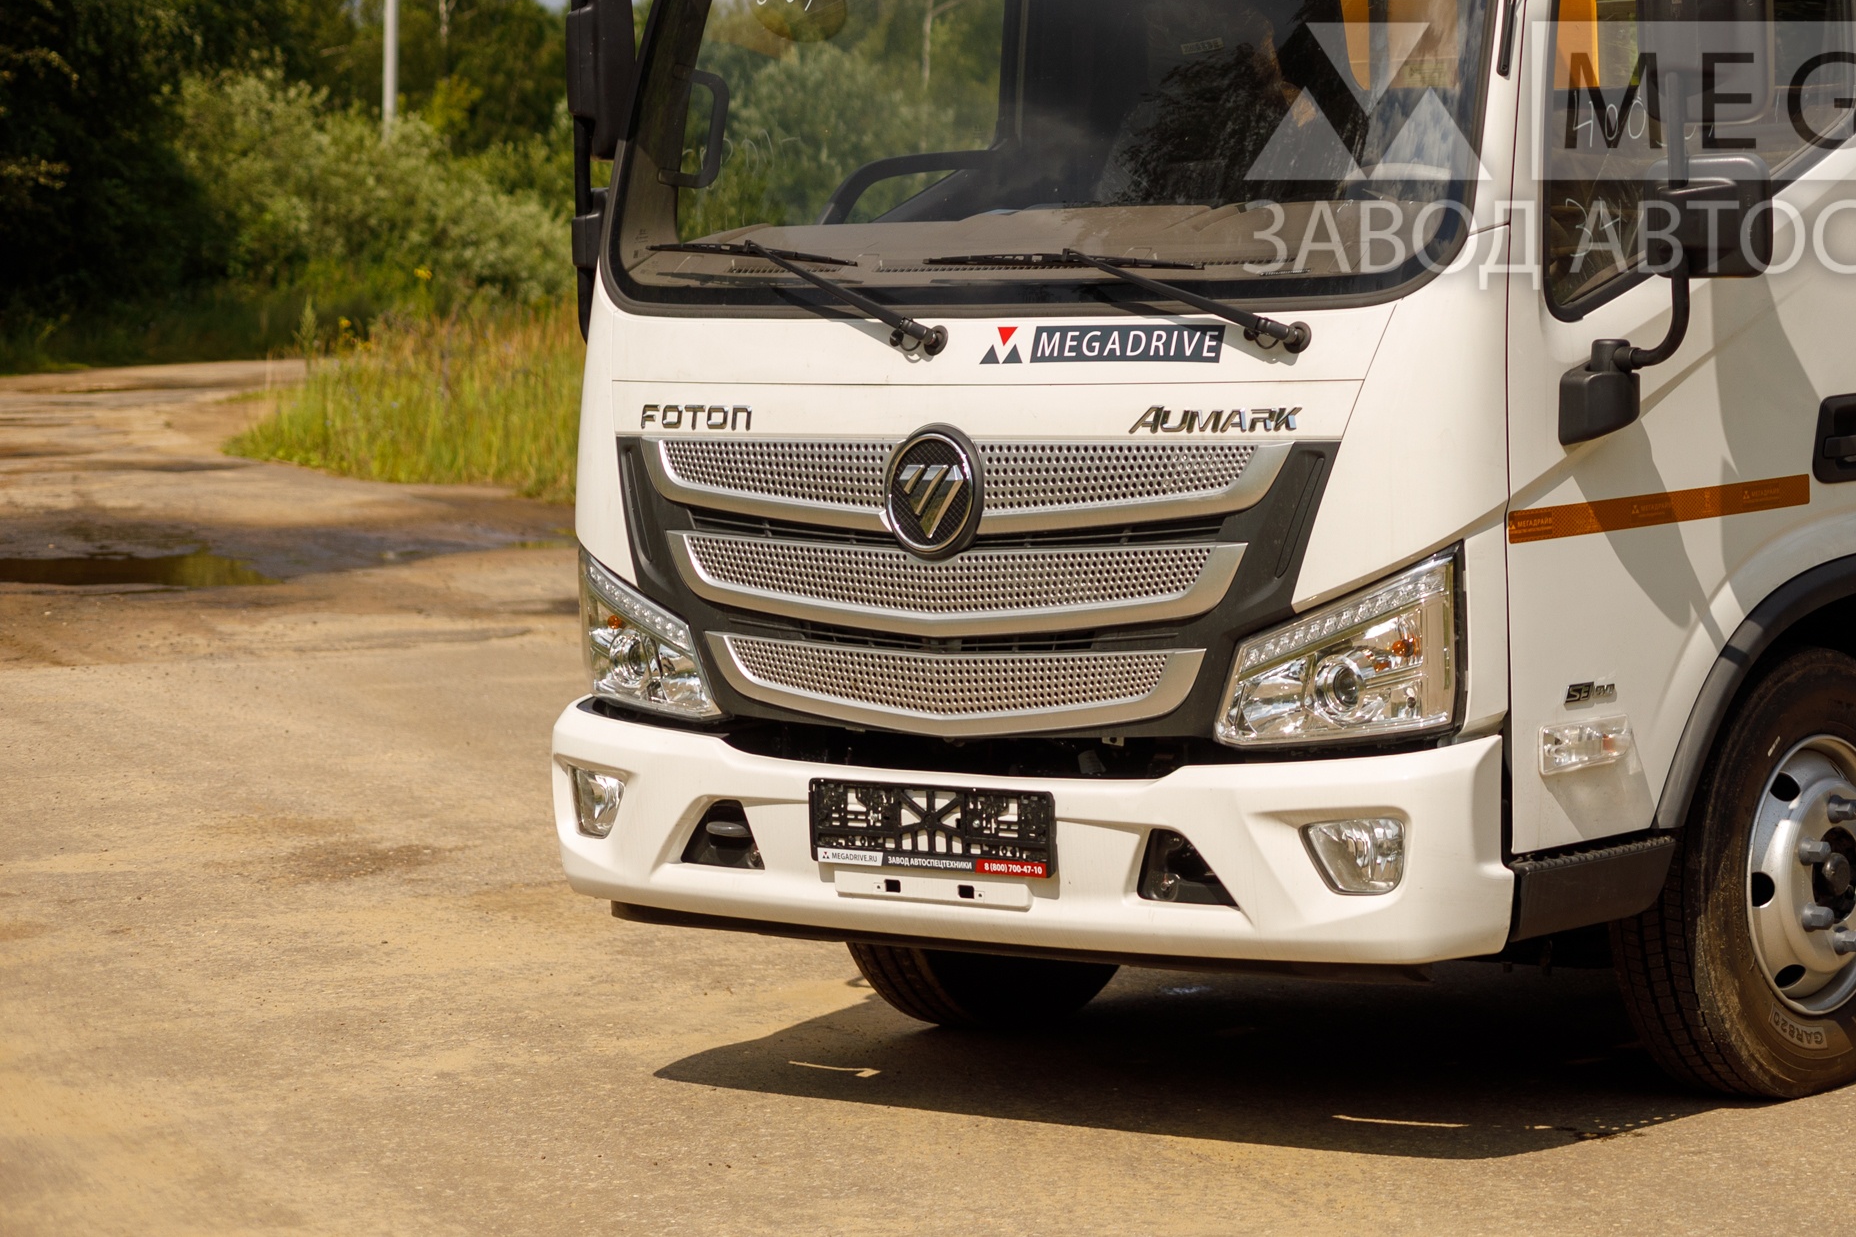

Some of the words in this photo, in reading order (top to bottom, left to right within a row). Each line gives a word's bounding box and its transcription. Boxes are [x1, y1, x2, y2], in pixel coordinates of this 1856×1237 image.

[1036, 326, 1220, 360] MEGADRIVE
[640, 404, 753, 431] FOTON
[1128, 404, 1303, 434] AUMARK
[831, 852, 878, 863] MEGADRIVE.RU
[887, 856, 909, 867] ЗАВОД
[910, 857, 973, 870] АВТОСПЕЦТЕХНИКИ
[984, 863, 989, 871] 8
[990, 863, 1008, 873] (800)
[1008, 864, 1043, 875] 700-47-10
